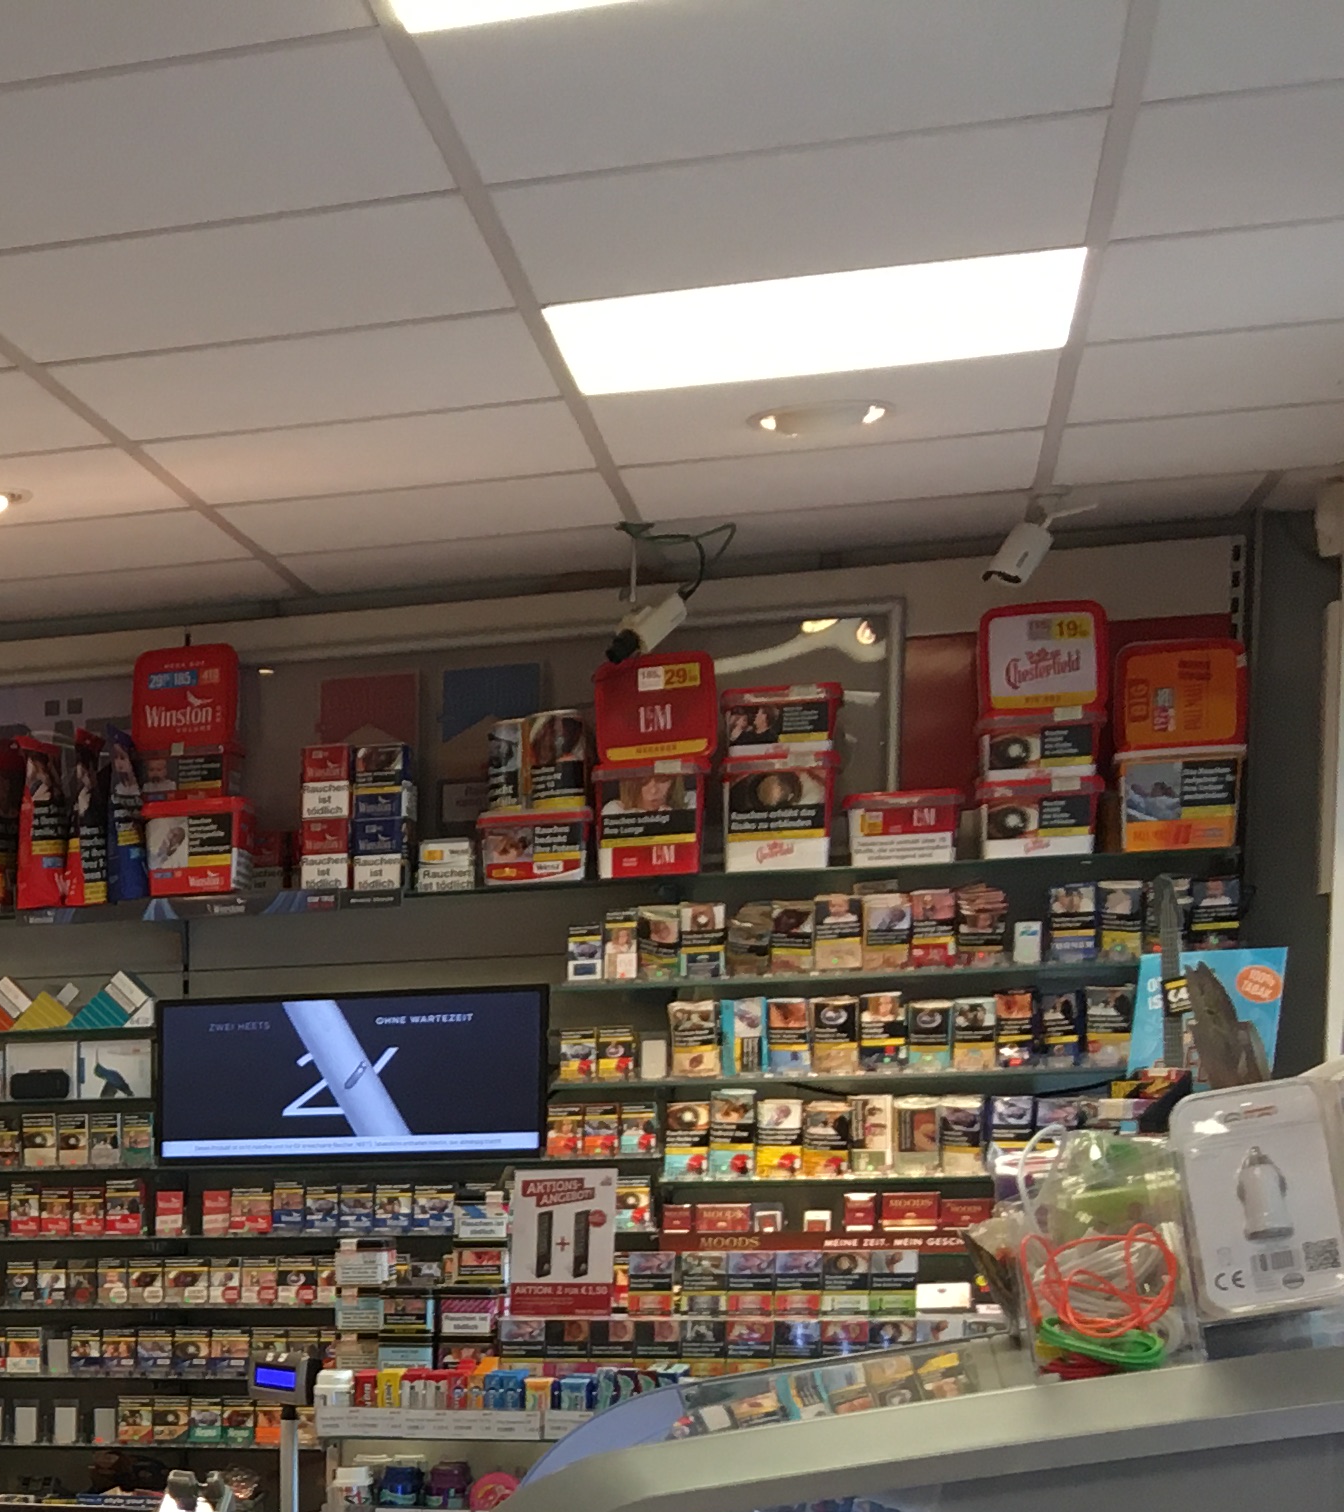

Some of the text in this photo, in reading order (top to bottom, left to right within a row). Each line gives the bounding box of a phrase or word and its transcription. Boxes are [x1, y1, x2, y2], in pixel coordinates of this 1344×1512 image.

[1005, 650, 1081, 690] Chesterfield
[145, 705, 212, 728] Winston
[1249, 969, 1276, 986] 100%
[1241, 982, 1273, 999] TABAK
[375, 1012, 474, 1025] OHNE WARTEZEIT
[527, 1179, 583, 1194] AKTIONS-
[700, 1236, 924, 1249] MOODS MEINE MEIN
